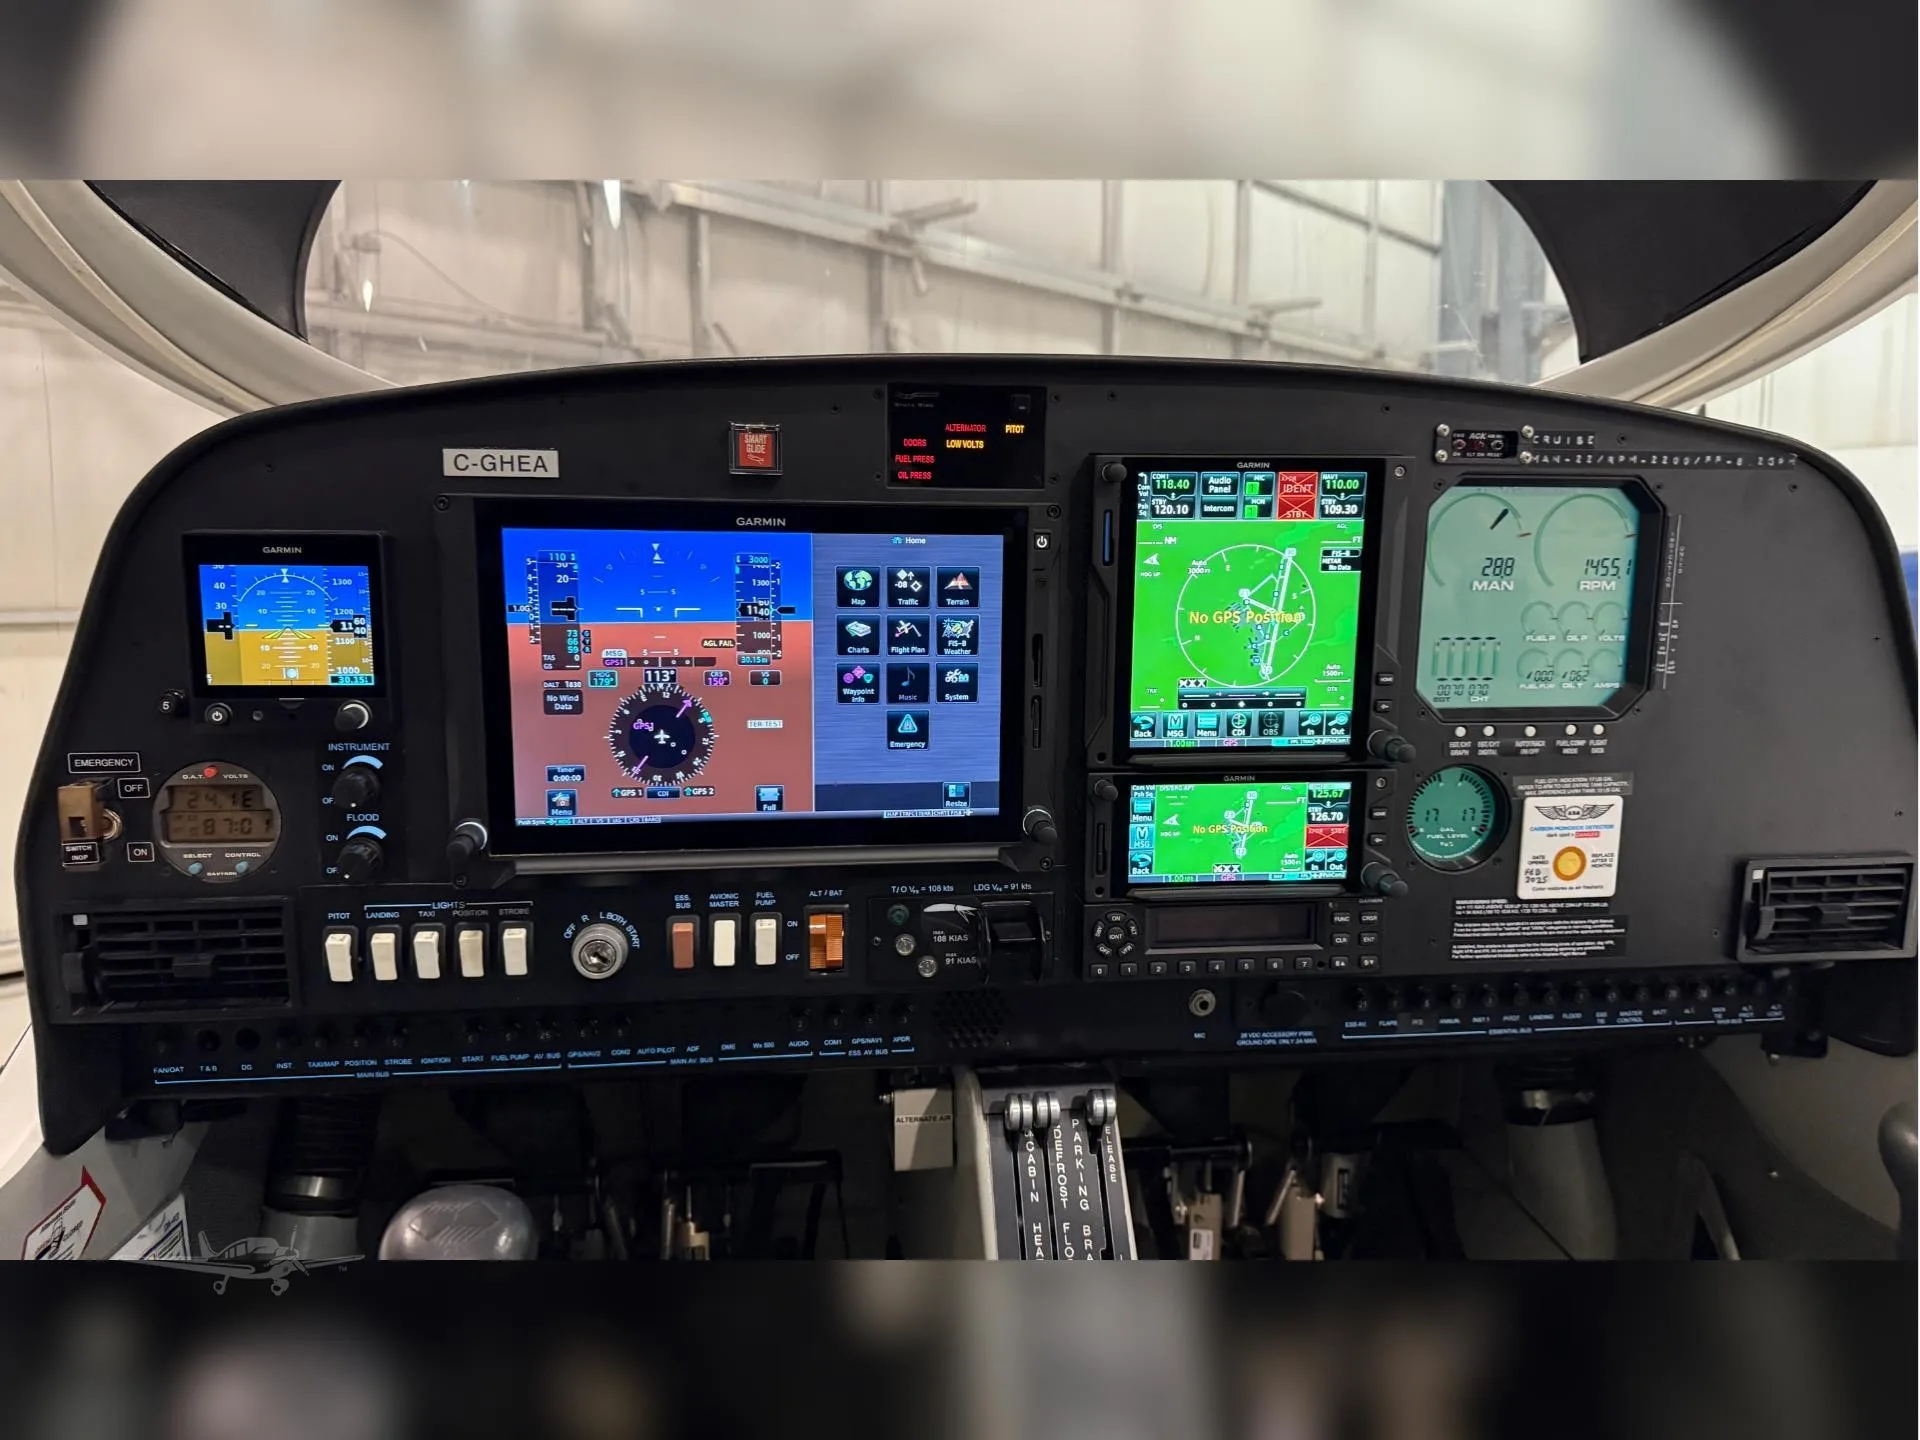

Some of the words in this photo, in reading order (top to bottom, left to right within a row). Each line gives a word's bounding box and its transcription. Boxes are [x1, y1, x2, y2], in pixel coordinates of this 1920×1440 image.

[945, 424, 986, 432] ALTERNATOR
[1005, 425, 1025, 433] PITOT
[744, 434, 767, 445] SMART
[903, 439, 927, 447] DOORS
[1532, 435, 1594, 445] CRUISE
[946, 440, 961, 448] LOW
[963, 440, 984, 449] VOLTS
[746, 445, 766, 455] GLIDE
[453, 454, 548, 473] C-GHEA
[895, 455, 911, 463] FUEL
[913, 455, 935, 463] PRESS
[898, 471, 909, 479] OIL
[910, 471, 932, 479] PRESS
[1155, 480, 1190, 490] 118.40
[1208, 476, 1232, 485] Audio
[1325, 480, 1359, 490] 110.00
[1208, 485, 1231, 493] Panel
[1283, 484, 1313, 493] IDENT
[1154, 505, 1189, 515] 120.10
[1204, 504, 1234, 512] Intercom
[1324, 505, 1358, 515] 109.30
[736, 517, 786, 526] GARMIN
[905, 537, 926, 545] Home
[1164, 537, 1177, 545] NM
[262, 546, 302, 554] GARMIN
[748, 555, 769, 564] 3000
[332, 578, 353, 586] 1300
[556, 575, 569, 583] 20
[752, 578, 770, 586] 1300
[213, 582, 226, 590] 40
[1472, 580, 1514, 591] MAN
[1579, 580, 1616, 591] RPM
[215, 602, 227, 610] 30
[851, 598, 866, 606] Map
[898, 598, 919, 606] Traffic
[946, 598, 970, 606] Terrain
[334, 608, 354, 616] 1200
[1189, 611, 1208, 624] No
[1213, 611, 1241, 624] GPS
[847, 646, 870, 654] Charts
[891, 646, 909, 655] Flight
[910, 646, 925, 654] Plan
[645, 669, 675, 682] 113°
[843, 688, 875, 697] Waypoint
[898, 693, 918, 701] Music
[546, 694, 558, 702] No
[559, 693, 579, 702] Wind
[945, 693, 969, 702] System
[162, 701, 169, 710] 5
[1134, 729, 1152, 738] Back
[1166, 729, 1184, 737] MSG
[1197, 729, 1217, 737] Menu
[1231, 728, 1246, 736] CDI
[1263, 728, 1279, 736] OBS
[328, 743, 391, 751] INSTRUMENT
[889, 740, 926, 750] Emergency
[74, 757, 134, 768] EMERGENCY
[321, 763, 335, 771] ON
[124, 783, 143, 793] OFF
[620, 788, 636, 797] GPS
[637, 788, 643, 796] 1
[692, 788, 707, 796] GPS
[708, 787, 714, 795] 2
[1311, 789, 1343, 799] 125.67
[763, 803, 777, 811] Full
[551, 808, 572, 816] Menu
[346, 814, 380, 822] FLOOD
[1132, 814, 1153, 822] Menu
[1310, 812, 1344, 822] 126.70
[1193, 825, 1206, 834] No
[1208, 825, 1227, 834] GPS
[1230, 824, 1268, 833] Position
[326, 834, 339, 842] ON
[65, 844, 92, 853] SWITCH
[133, 847, 148, 857] ON
[1132, 867, 1150, 875] Back
[1329, 863, 1343, 871] Out
[1525, 876, 1548, 884] 2025
[829, 889, 843, 897] BAT
[432, 901, 465, 910] LIGHTS
[328, 912, 350, 920] PITOT
[564, 923, 577, 939] OFF
[625, 925, 640, 949] START
[945, 957, 955, 965] 91
[637, 1047, 656, 1055] AUTO
[656, 1046, 676, 1054] PILOT
[462, 1055, 484, 1063] START
[491, 1054, 508, 1062] FUEL
[509, 1053, 530, 1061] PUMP
[895, 1115, 936, 1123] ALTERNATE
[937, 1114, 951, 1122] AIR
[1105, 1126, 1117, 1182] ELEASE
[1071, 1119, 1090, 1210] PARKING
[1053, 1128, 1068, 1209] DEFROST
[1063, 1223, 1075, 1260] FLO
[1025, 1140, 1039, 1203] CABIN
[1032, 1223, 1046, 1260] HEA
